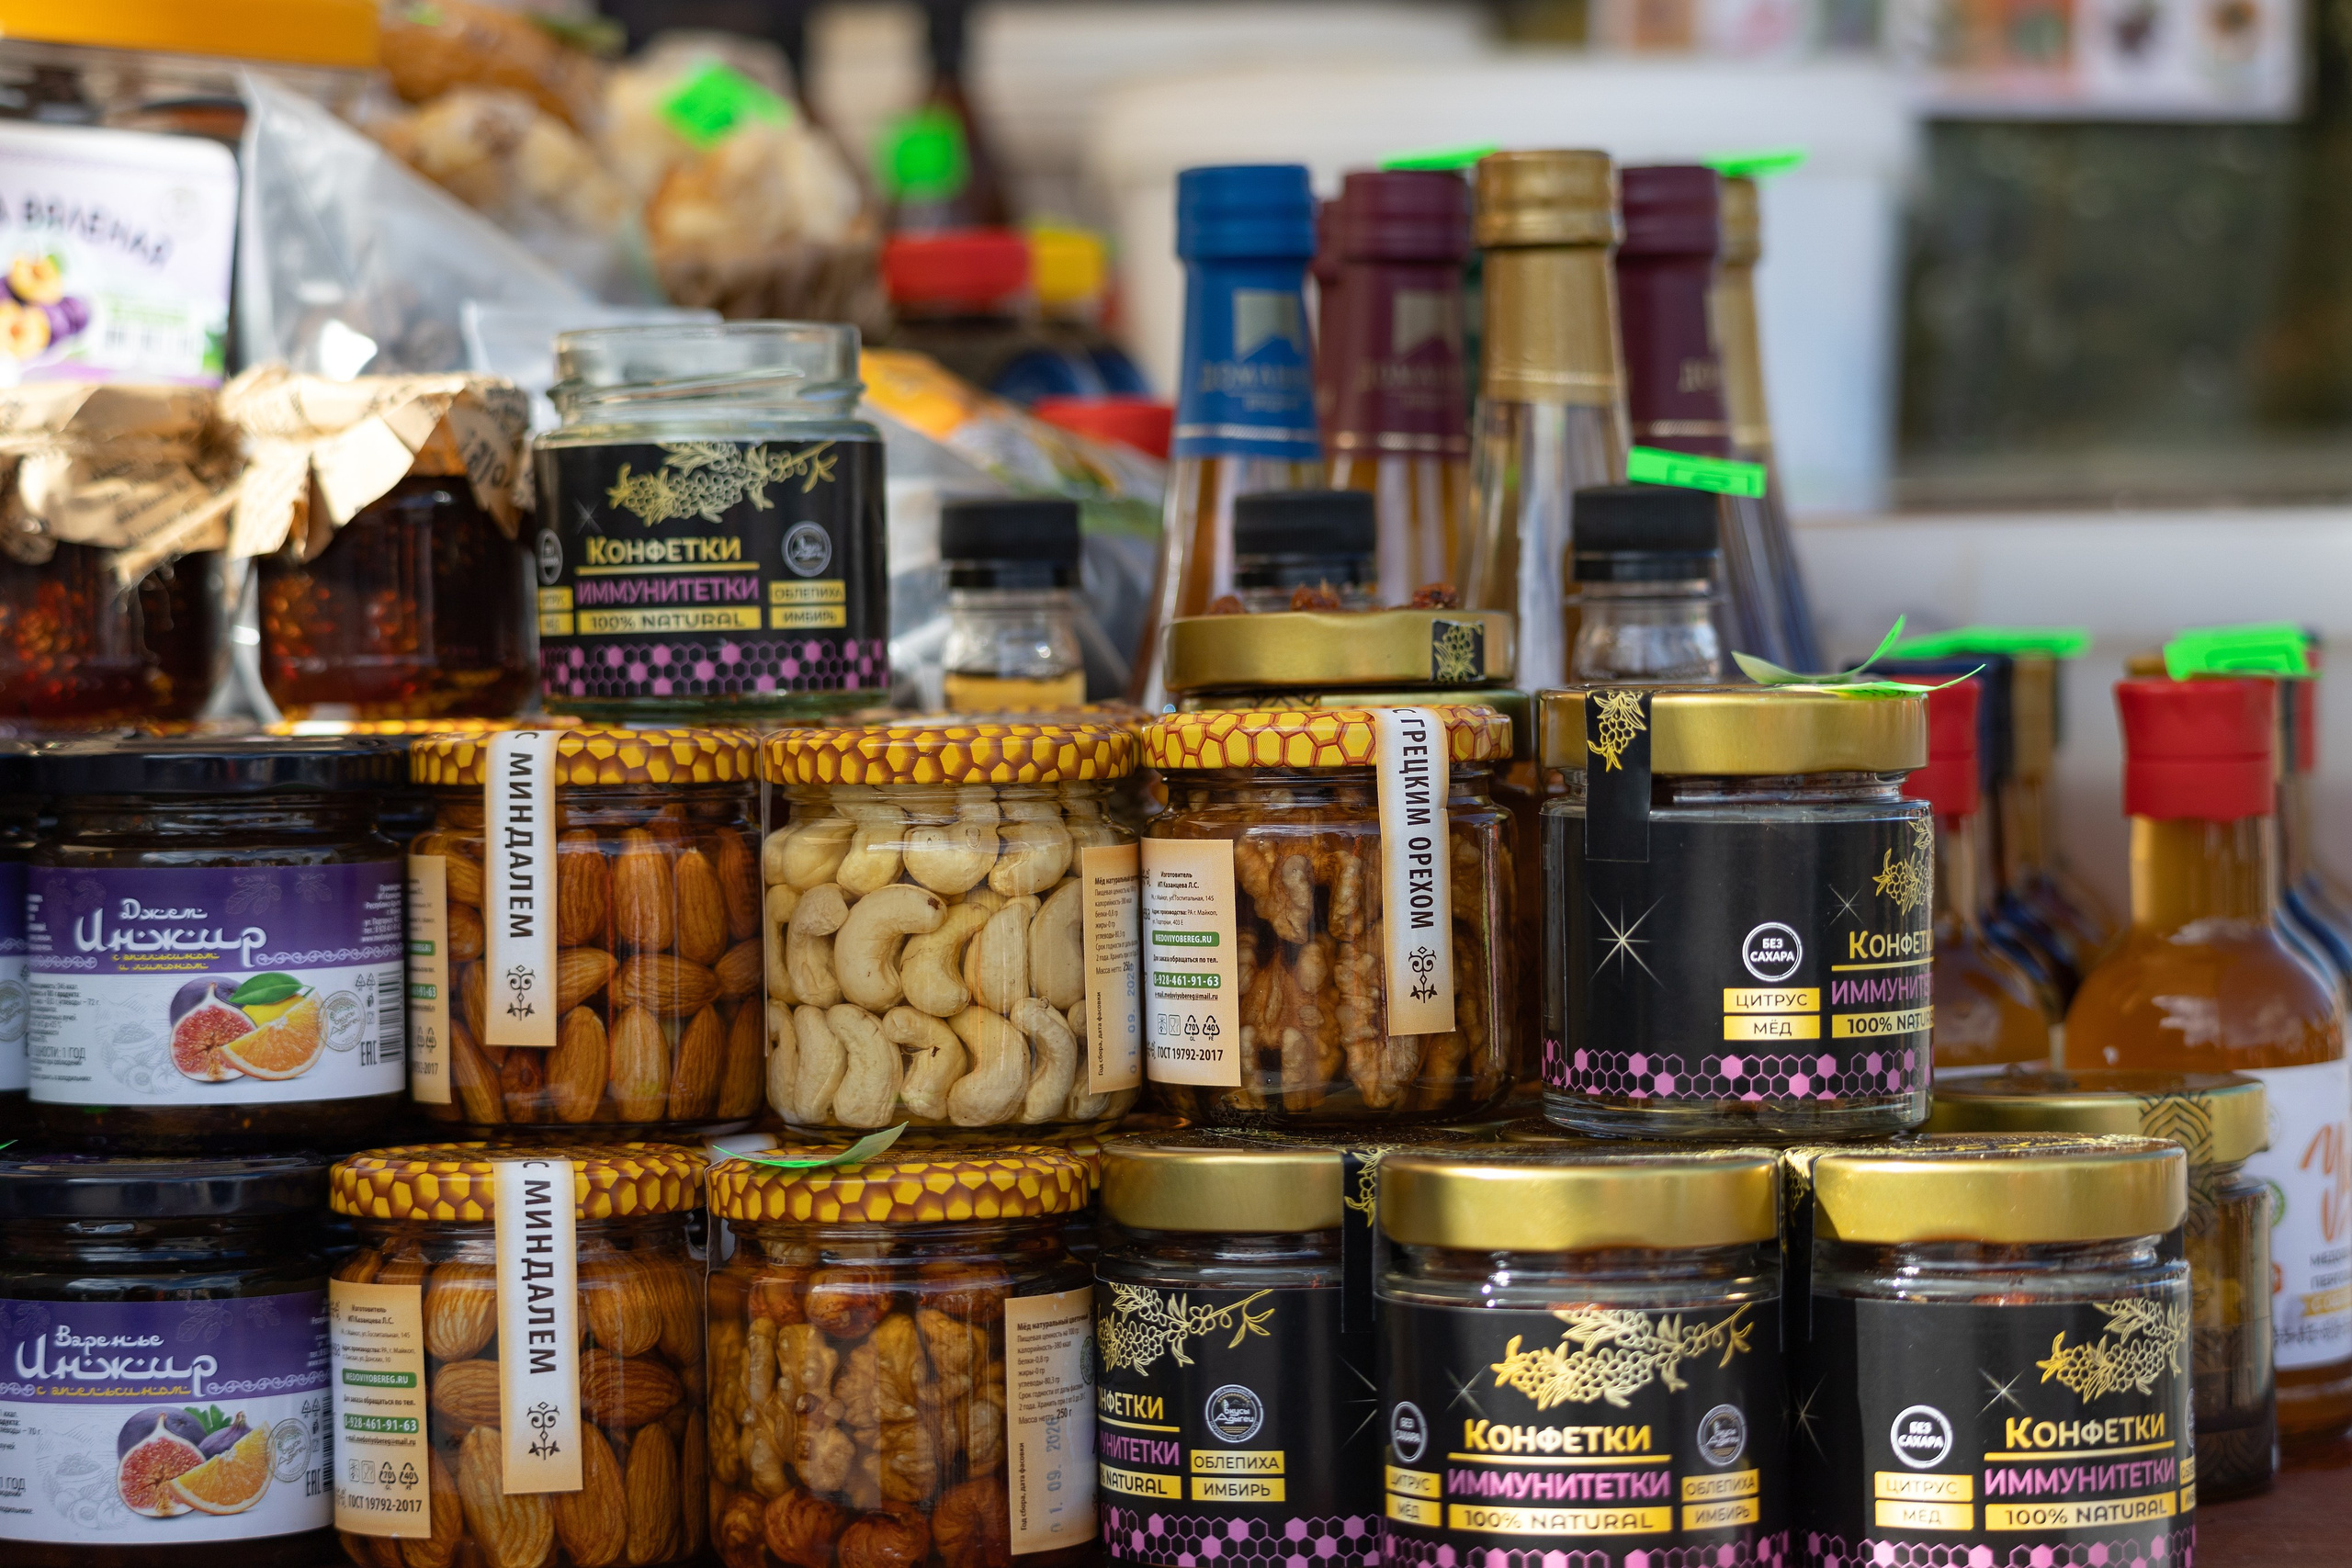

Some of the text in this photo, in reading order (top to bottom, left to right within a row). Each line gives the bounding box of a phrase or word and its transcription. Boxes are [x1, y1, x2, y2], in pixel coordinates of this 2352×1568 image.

[586, 536, 741, 565] КОНФЕТКИ
[575, 577, 760, 605] ИММУНИТЕТКИ
[775, 588, 842, 600] ОБЛЕПИХА
[590, 613, 745, 630] 100% NATURAL
[784, 611, 837, 624] ИМБИРЬ
[1399, 718, 1431, 826] ГРЕЦКИМ
[504, 751, 534, 939] МИНДАЛЕМ
[1408, 837, 1435, 930] ОРЕХОМ
[120, 897, 209, 919] Джем
[74, 908, 267, 968] Инжир
[1155, 933, 1213, 943] MEDOVIYOBEREG.RU
[1761, 937, 1784, 950] БЕЗ
[122, 952, 220, 962] апельсином
[1170, 955, 1199, 964] обращаться
[1749, 950, 1795, 964] САХАРА
[132, 962, 209, 971] лимоном
[1154, 975, 1219, 987] 8-928-461-91-63
[1736, 993, 1808, 1010] ЦИТРУС
[1207, 1023, 1216, 1032] 40
[1754, 1017, 1792, 1037] МЁД
[1848, 1016, 1893, 1034] 100%
[69, 1047, 86, 1062] ГОД
[1158, 1046, 1224, 1061] ГОСТ 19792-2017
[521, 1179, 557, 1375] МИНДАЛЕМ
[1017, 1316, 1069, 1331] Мёд натуральный
[53, 1325, 165, 1355] Варенье
[1017, 1335, 1041, 1343] Пищевая
[16, 1333, 220, 1398] Инжир
[51, 1383, 192, 1397] апельсином
[1018, 1392, 1032, 1401] Срок
[1018, 1416, 1037, 1425] Масса
[1056, 1408, 1068, 1419] 250
[1464, 1418, 1651, 1454] КОНФЕТКИ
[1908, 1421, 1932, 1435] БЕЗ
[2006, 1413, 2166, 1450] КОНФЕТКИ
[1101, 1430, 1180, 1466] УНИТЕТКИ
[1896, 1434, 1944, 1450] САХАРА
[1193, 1456, 1280, 1470] ОБЛЕПИХА
[6, 1477, 26, 1492] ГОД
[1106, 1471, 1168, 1495] NATURAL
[1447, 1469, 1672, 1501] ИММУНИТЕТКИ
[1984, 1457, 2177, 1497] ИММУНИТЕТКИ
[1204, 1483, 1272, 1497] ИМБИРЬ
[1684, 1476, 1755, 1496] ОБЛЕПИХА
[1886, 1478, 1959, 1495] ЦИТРУС
[348, 1494, 423, 1513] ГОСТ 19792-2017
[1464, 1509, 1654, 1531] 100% NATURAL
[1695, 1505, 1750, 1524] ИМБИРЬ
[2006, 1500, 2168, 1526] 100% NATURAL
